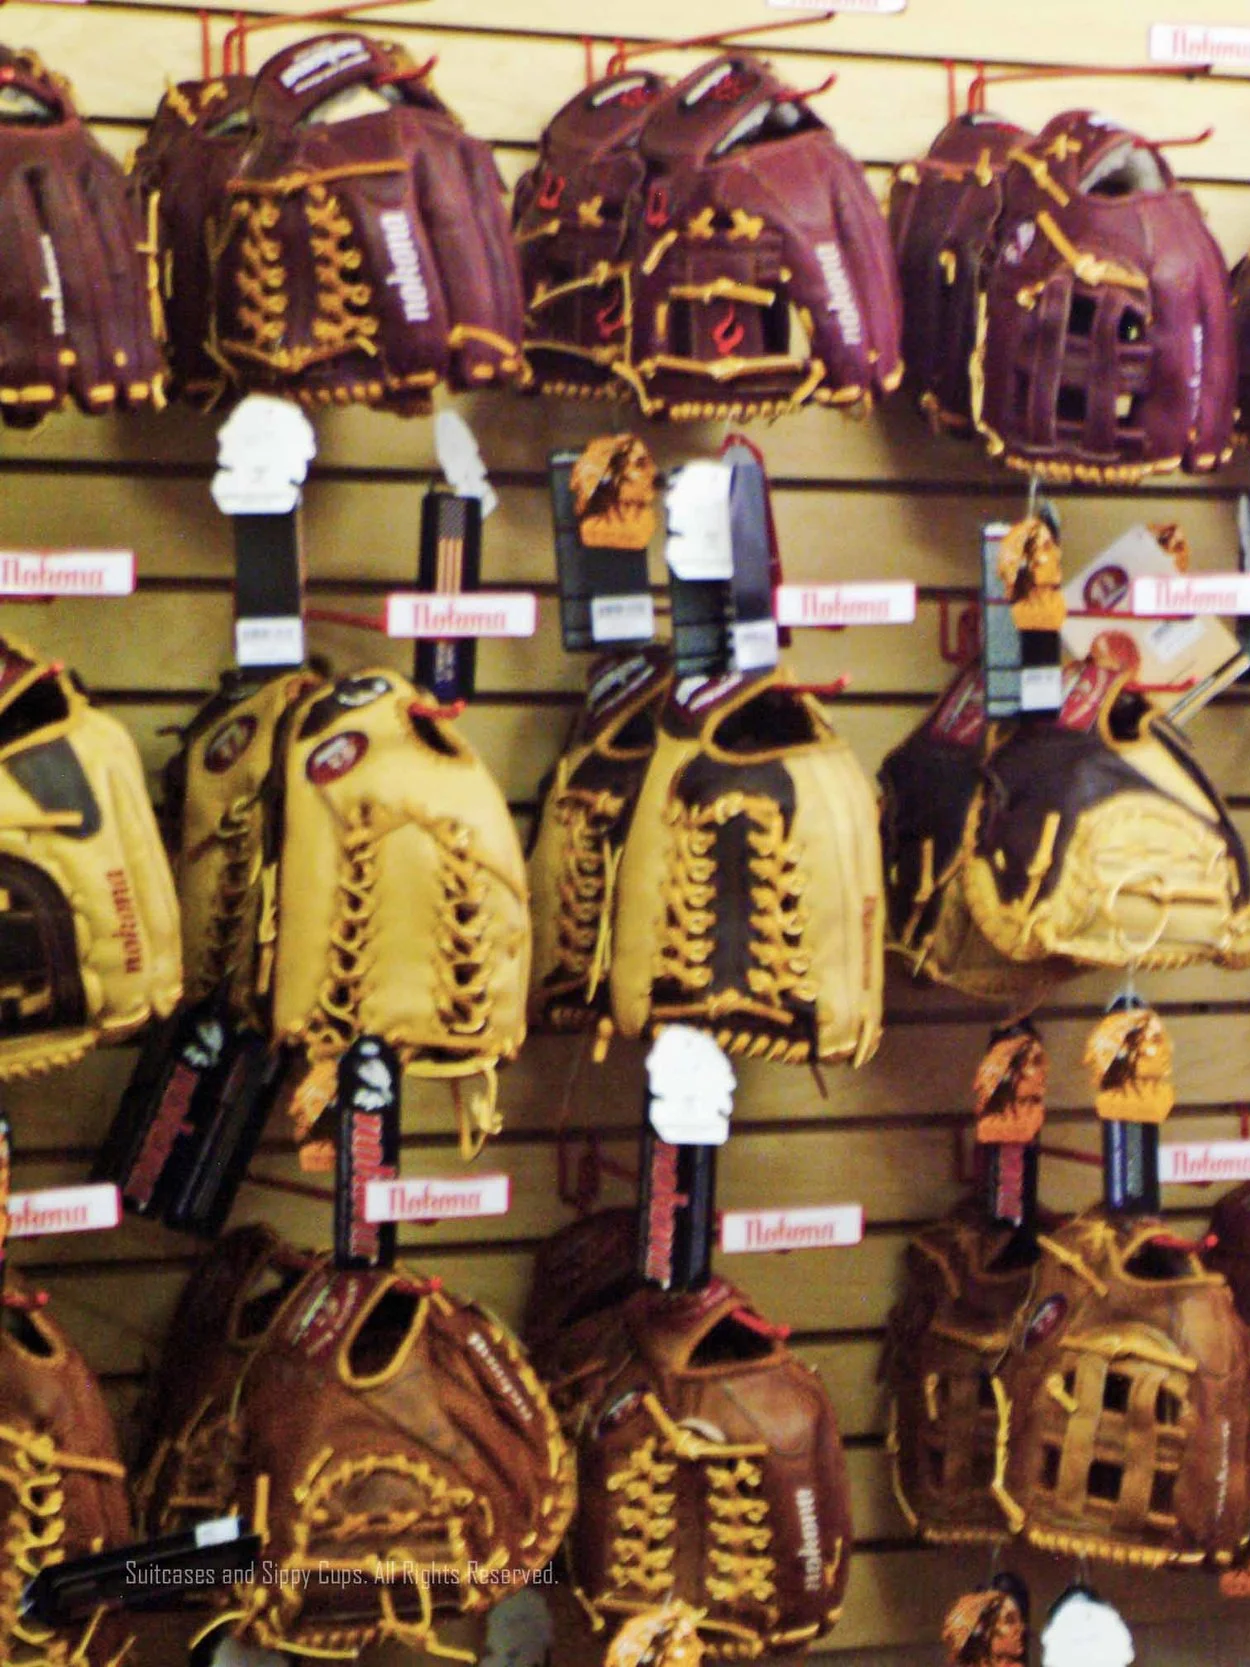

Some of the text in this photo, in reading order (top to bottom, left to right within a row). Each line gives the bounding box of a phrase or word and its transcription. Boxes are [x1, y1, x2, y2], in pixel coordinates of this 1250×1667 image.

[379, 209, 430, 321] nokona
[814, 241, 862, 345] nokona
[7, 1197, 88, 1228] okona
